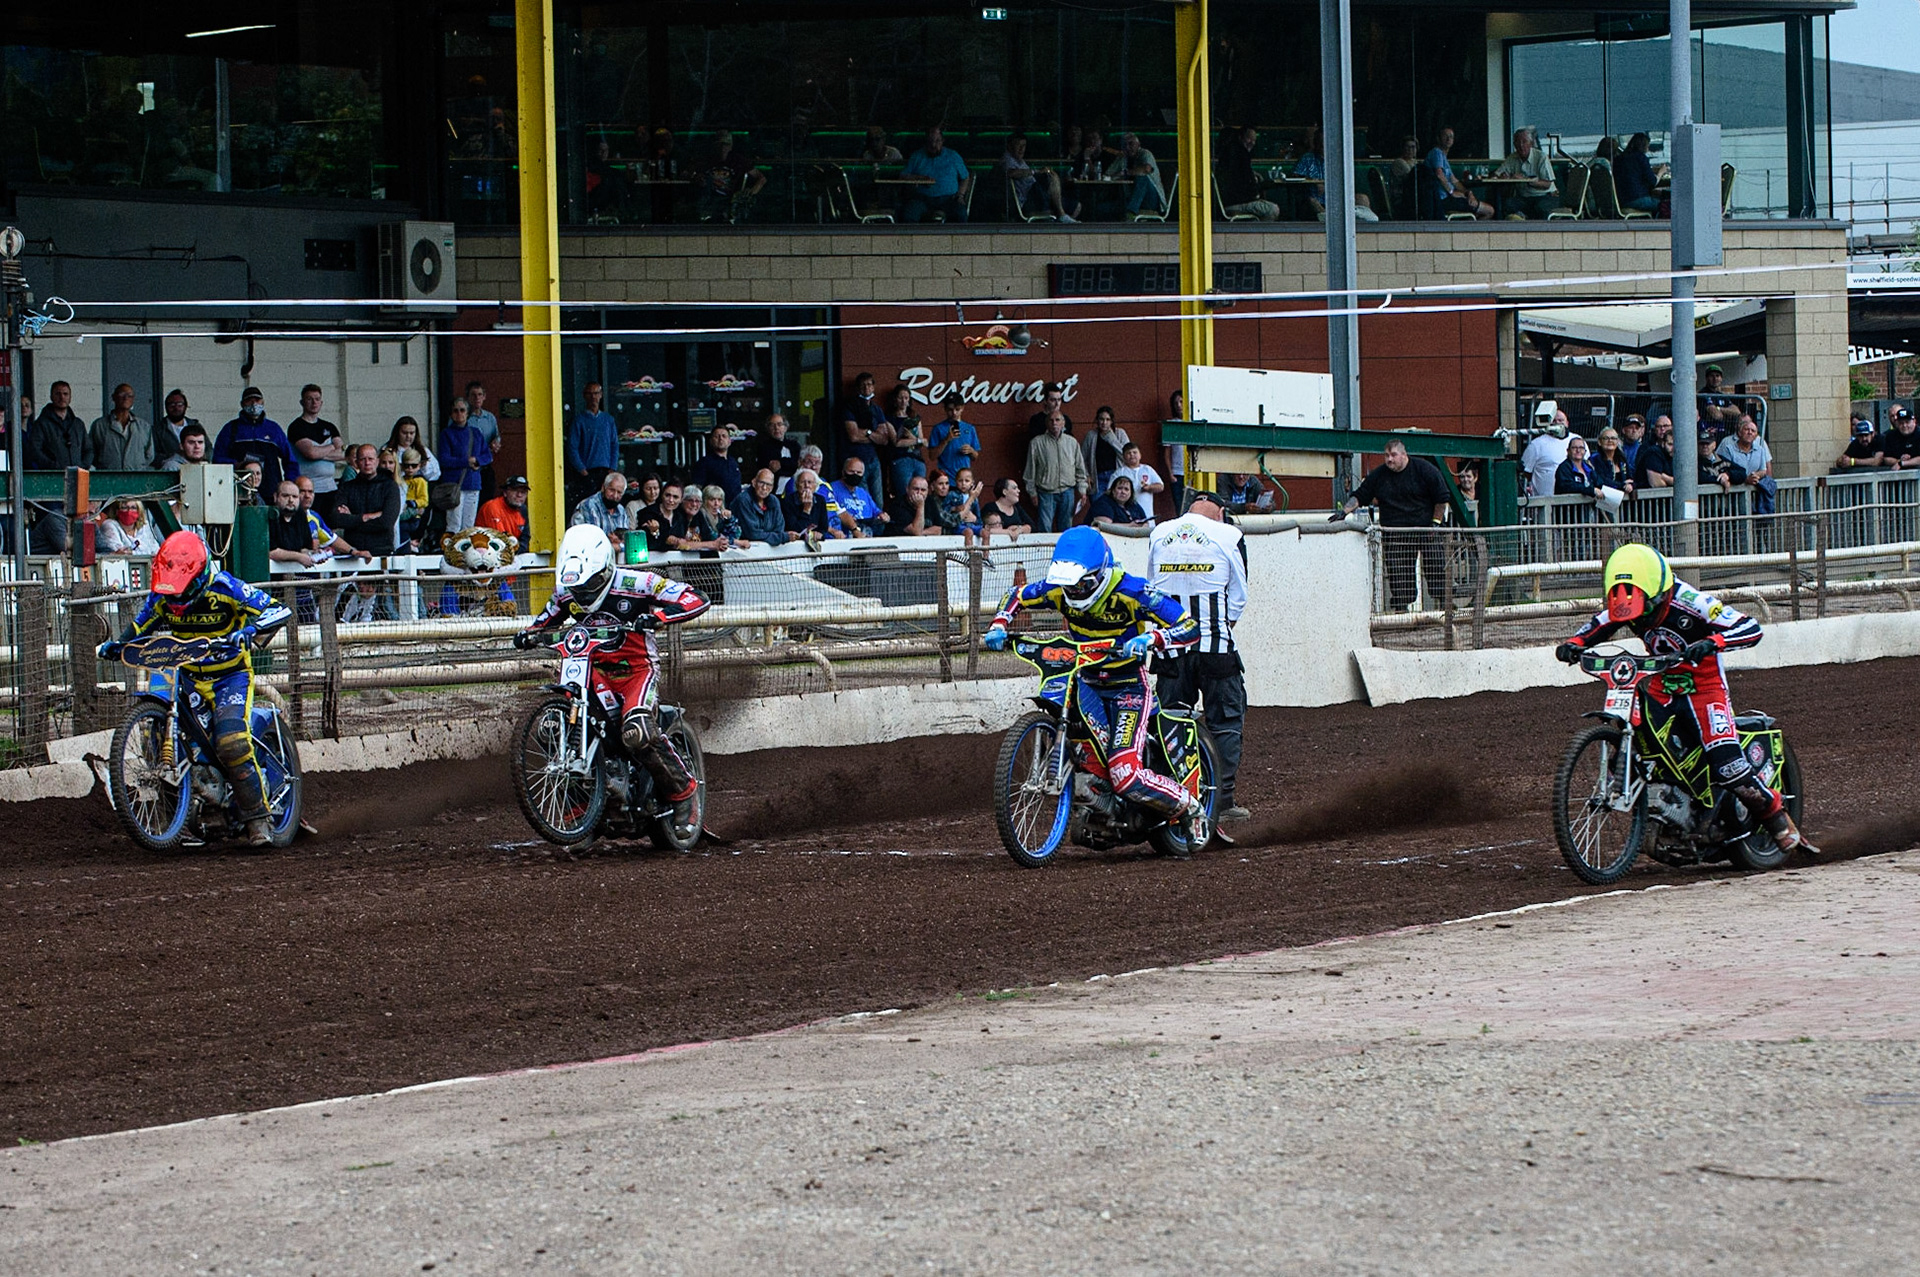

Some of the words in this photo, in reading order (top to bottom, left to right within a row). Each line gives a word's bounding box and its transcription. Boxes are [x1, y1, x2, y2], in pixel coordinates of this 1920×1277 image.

[900, 366, 1079, 405] Restaurat
[1161, 564, 1177, 572] TRU
[1178, 564, 1212, 572] PLANT
[208, 596, 219, 610] 2
[187, 614, 222, 623] PLANT
[1680, 618, 1689, 628] 7
[138, 646, 169, 658] Complete
[1114, 711, 1128, 746] MAXED
[1121, 712, 1136, 745] POWER
[1186, 727, 1195, 746] 7
[1110, 764, 1133, 784] STAR
